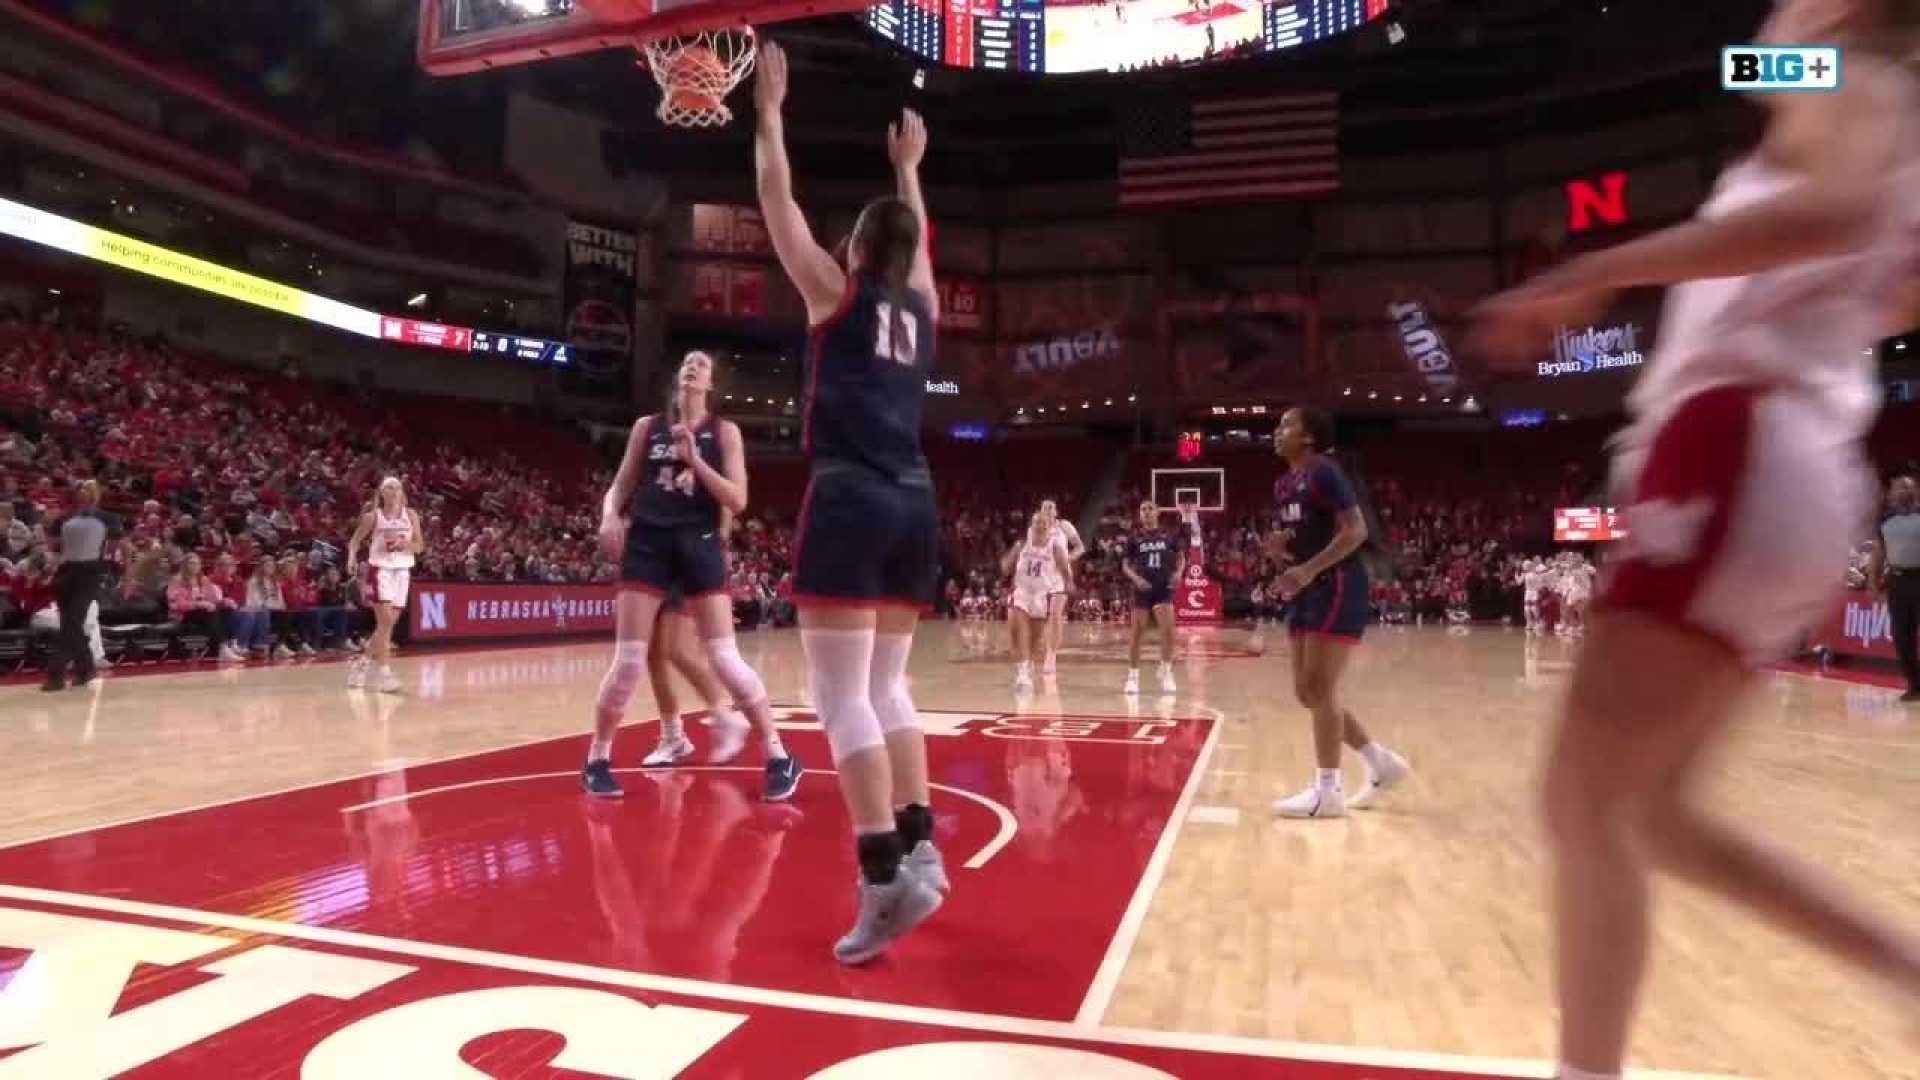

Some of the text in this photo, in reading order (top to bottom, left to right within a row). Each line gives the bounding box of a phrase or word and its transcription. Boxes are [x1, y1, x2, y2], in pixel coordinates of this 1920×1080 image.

[1566, 171, 1629, 231] N
[101, 240, 150, 264] Helping
[570, 242, 634, 276] WITH
[1538, 351, 1642, 376] Bryan Health
[1148, 552, 1162, 568] 11
[420, 591, 447, 630] N
[467, 600, 550, 620] NEBRASKA
